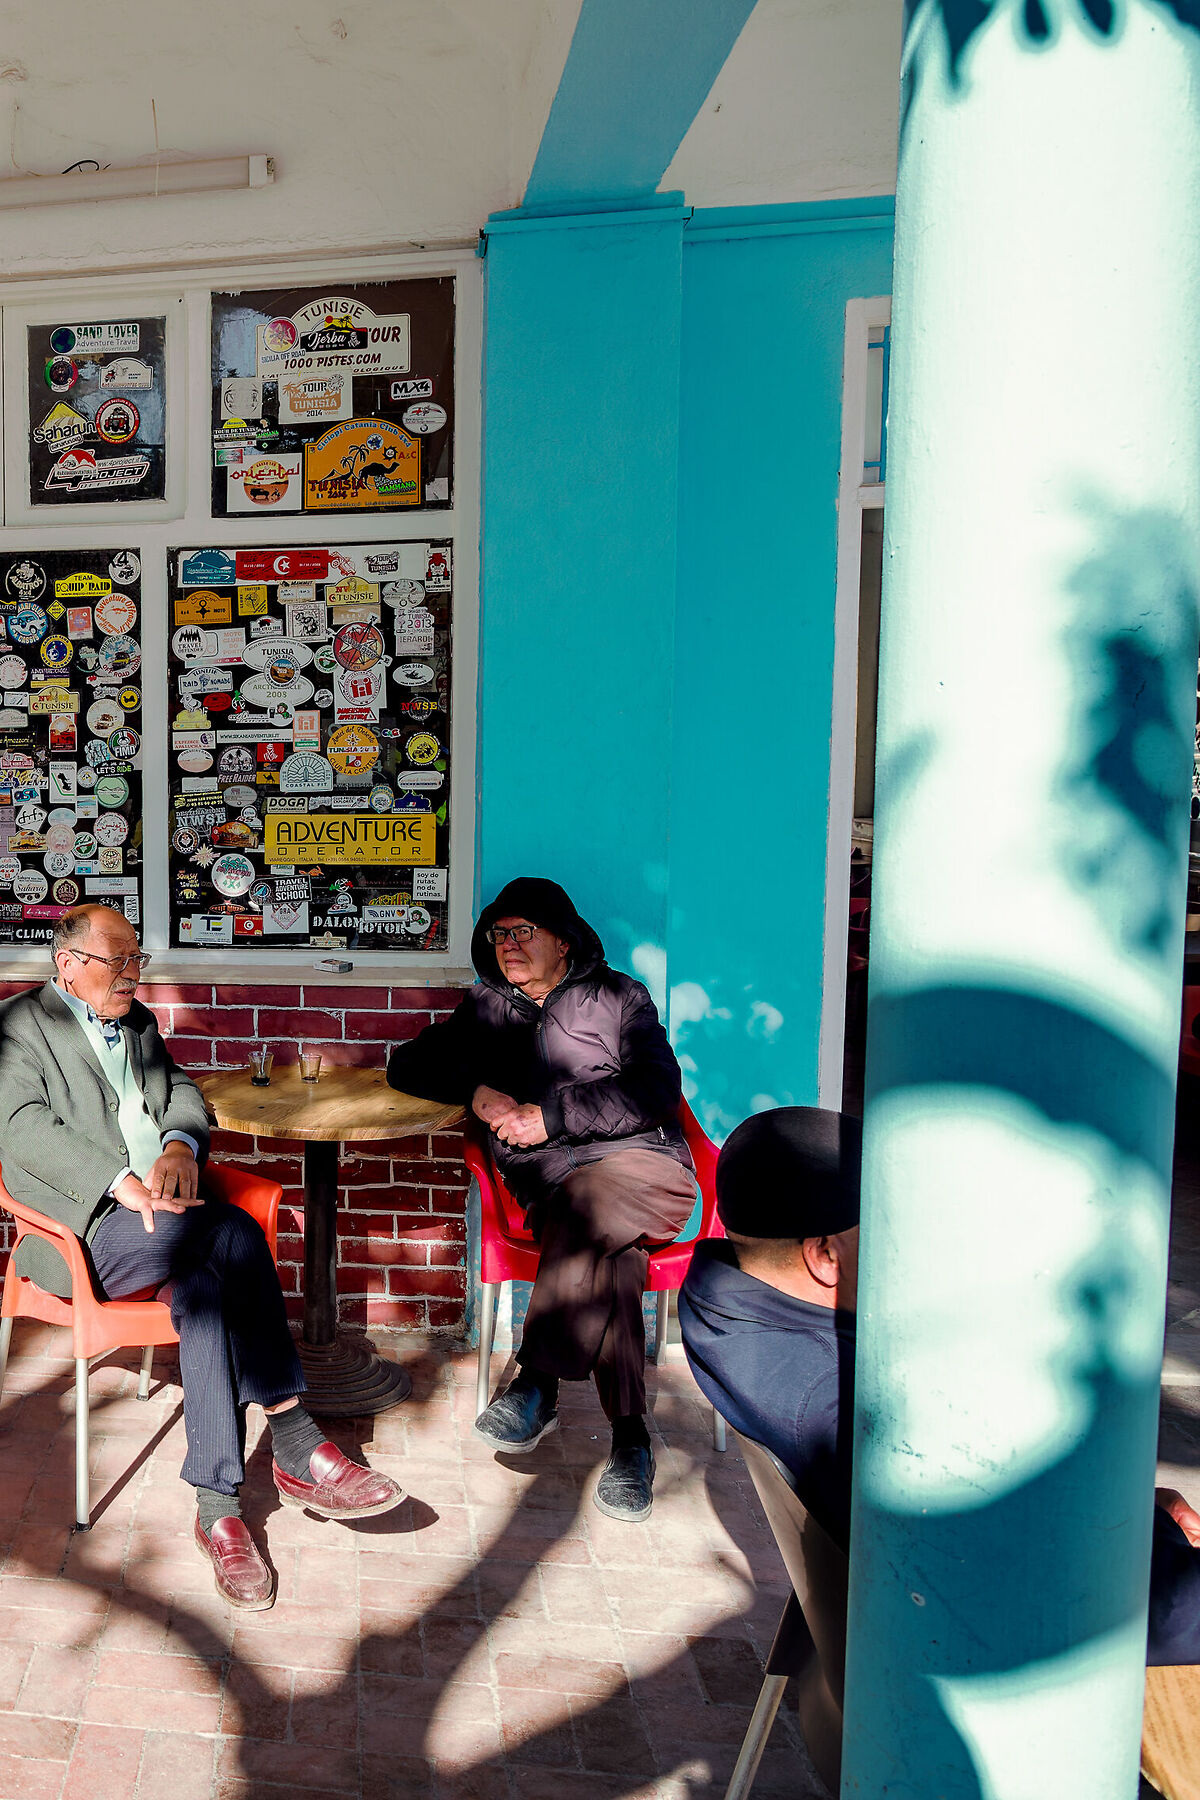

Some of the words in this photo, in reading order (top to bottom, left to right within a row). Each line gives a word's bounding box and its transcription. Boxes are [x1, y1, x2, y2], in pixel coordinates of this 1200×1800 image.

[301, 301, 364, 321] TUNISIE
[76, 327, 103, 339] SAND
[108, 325, 138, 338] LOVER
[76, 339, 114, 347] Adventure
[116, 338, 138, 346] Travel
[280, 351, 291, 361] OFF
[291, 350, 306, 359] ROAD
[284, 358, 313, 370] 1000
[317, 352, 382, 368] PISTES.COM
[303, 381, 327, 393] TOUR
[393, 381, 431, 394] MX4
[294, 398, 337, 410] TUNISIA
[307, 410, 323, 418] 2014
[317, 427, 344, 451] Ciclopi
[344, 421, 378, 431] Catania
[379, 422, 398, 436] Club
[398, 451, 417, 460] A&C
[230, 462, 300, 480] oriental
[308, 478, 367, 493] TUNISIA
[327, 490, 348, 499] 2014
[371, 564, 396, 572] TUNISIA
[9, 575, 44, 591] ALBATROS
[335, 591, 374, 601] TUNISIE
[407, 619, 433, 629] 2013
[101, 636, 120, 656] FRIENDS
[121, 636, 138, 647] CLUB
[261, 648, 295, 656] TUNISIA
[401, 702, 438, 711] NWSE
[114, 746, 136, 757] FIMD
[330, 757, 344, 771] CLUB
[96, 766, 116, 774] LET'S
[116, 765, 132, 773] RIDE
[218, 773, 233, 783] FREE
[233, 773, 257, 783] RAIDER
[269, 797, 306, 807] DOGA
[175, 813, 227, 828] NWSE
[277, 819, 422, 842] ADVENTURE
[277, 846, 422, 856] OPERATOR
[275, 877, 308, 886] TRAVEL
[15, 882, 47, 892] Sahara
[275, 884, 309, 892] ADVENTURE
[275, 891, 310, 901] SCHOOL
[380, 909, 396, 917] GNV
[15, 928, 54, 939] CLIMB
